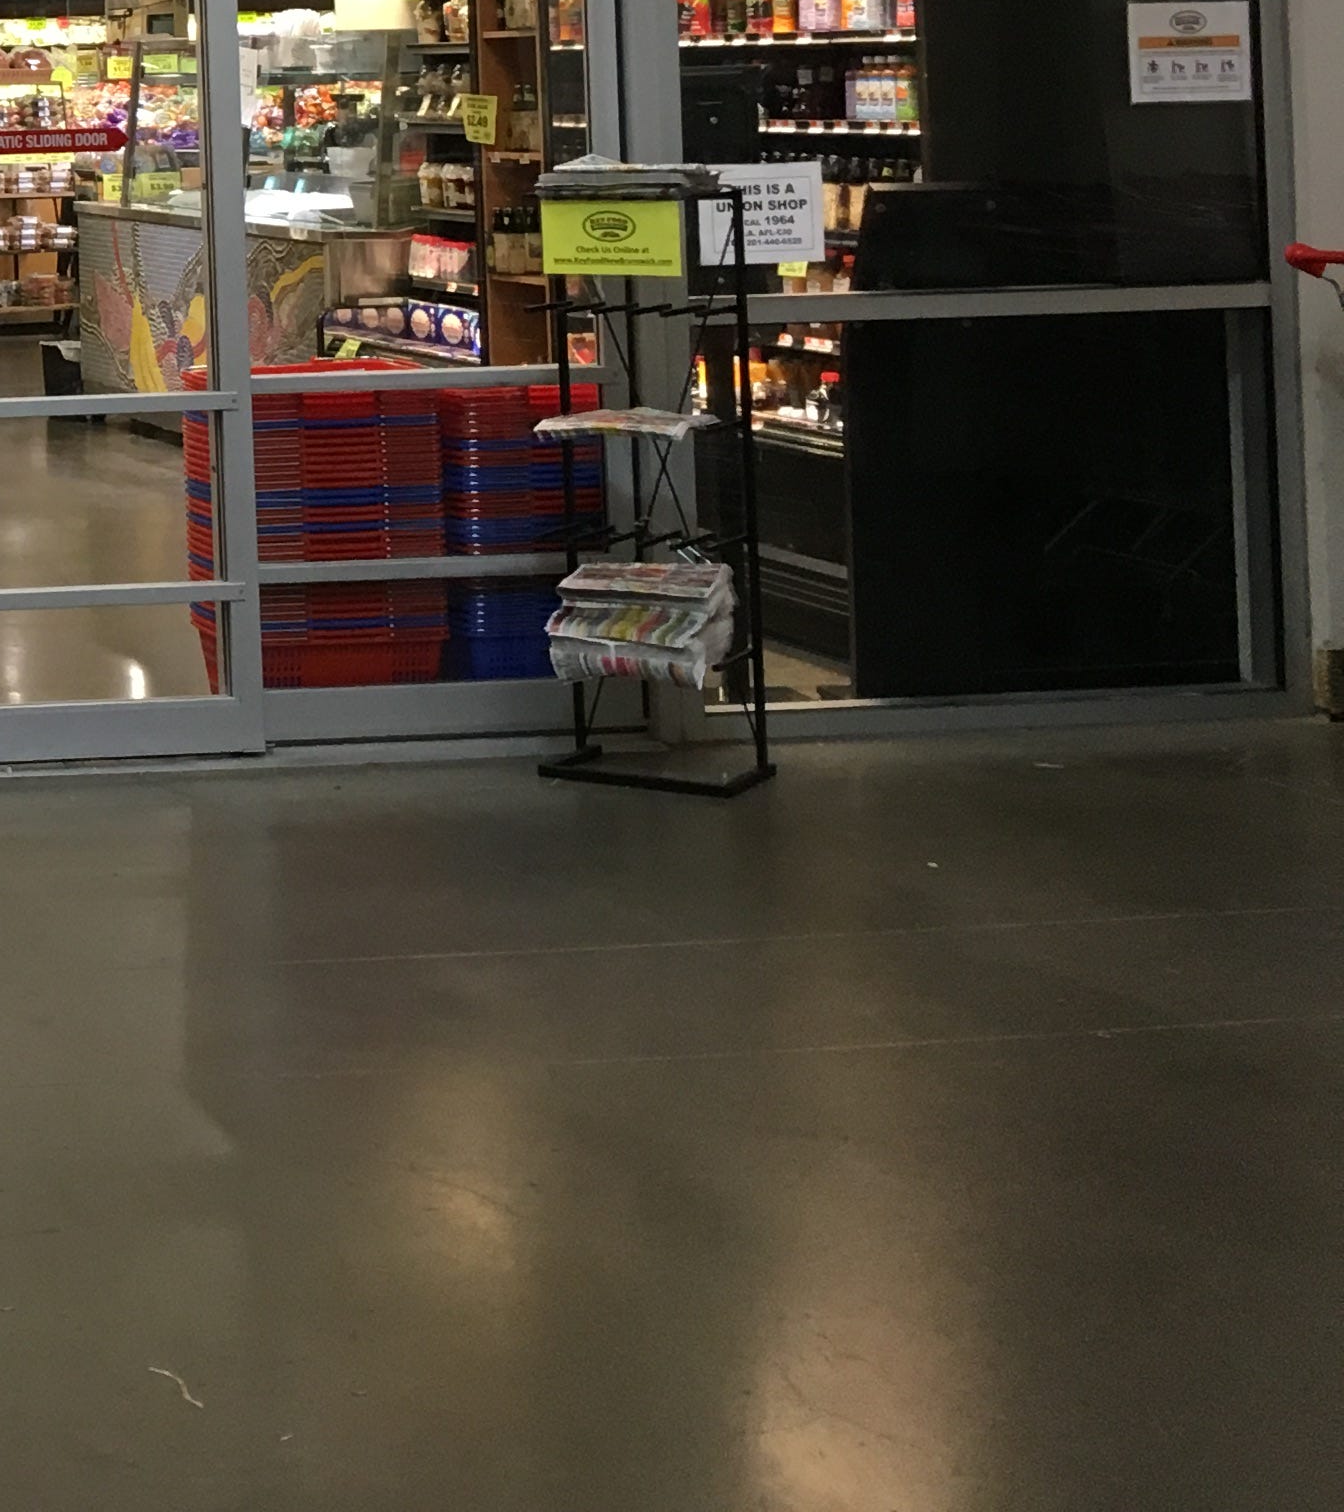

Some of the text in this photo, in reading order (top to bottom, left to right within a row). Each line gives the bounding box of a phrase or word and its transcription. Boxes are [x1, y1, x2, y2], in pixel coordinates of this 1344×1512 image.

[26, 135, 72, 148] SLIDING
[74, 133, 108, 146] DOOR
[741, 183, 795, 195] HIS IS A
[716, 199, 807, 212] UNON SHOP
[764, 216, 795, 225] 1964
[576, 246, 600, 254] Check
[602, 246, 611, 254] Us
[613, 245, 640, 254] Online
